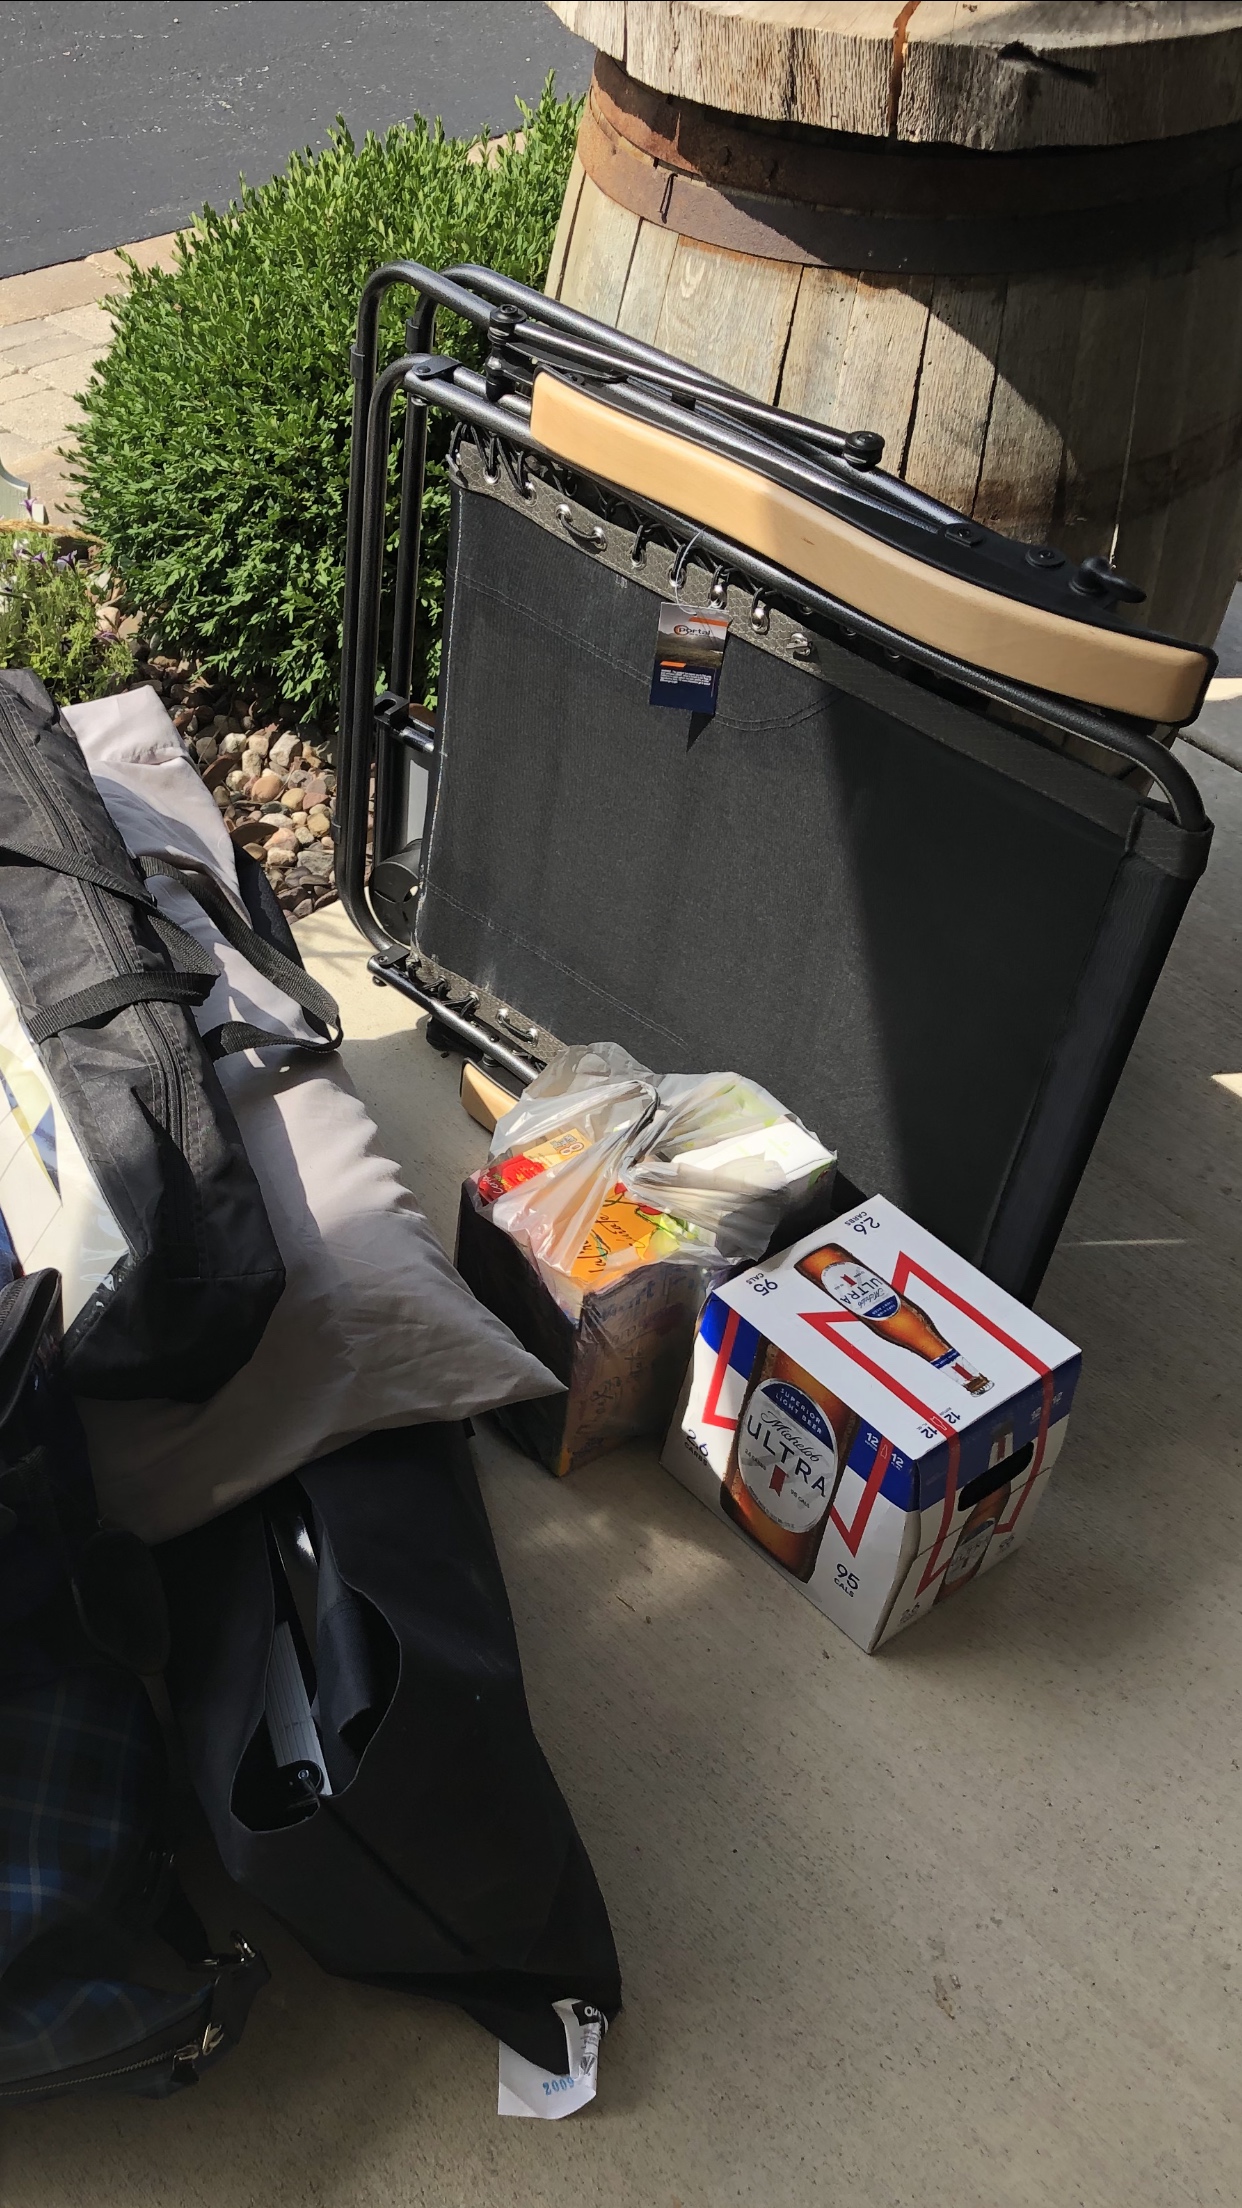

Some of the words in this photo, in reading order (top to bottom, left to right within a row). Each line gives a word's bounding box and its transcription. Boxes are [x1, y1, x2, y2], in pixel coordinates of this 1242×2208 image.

[844, 1211, 868, 1226] CARBS
[853, 1216, 881, 1235] 2.6
[746, 1272, 765, 1285] CALS
[753, 1278, 778, 1296] 95
[840, 1277, 883, 1305] ULTRA
[775, 1394, 799, 1415] LIGHT
[801, 1414, 823, 1435] BEER
[780, 1387, 822, 1424] SUPERIOR
[944, 1411, 961, 1424] 12
[760, 1410, 820, 1463] Michelob
[866, 1432, 880, 1444] 12
[921, 1426, 938, 1439] 12
[684, 1441, 708, 1466] CARBS
[747, 1414, 826, 1498] ULTRA
[891, 1453, 904, 1468] 12
[836, 1563, 860, 1590] 95
[834, 1577, 854, 1598] CALS
